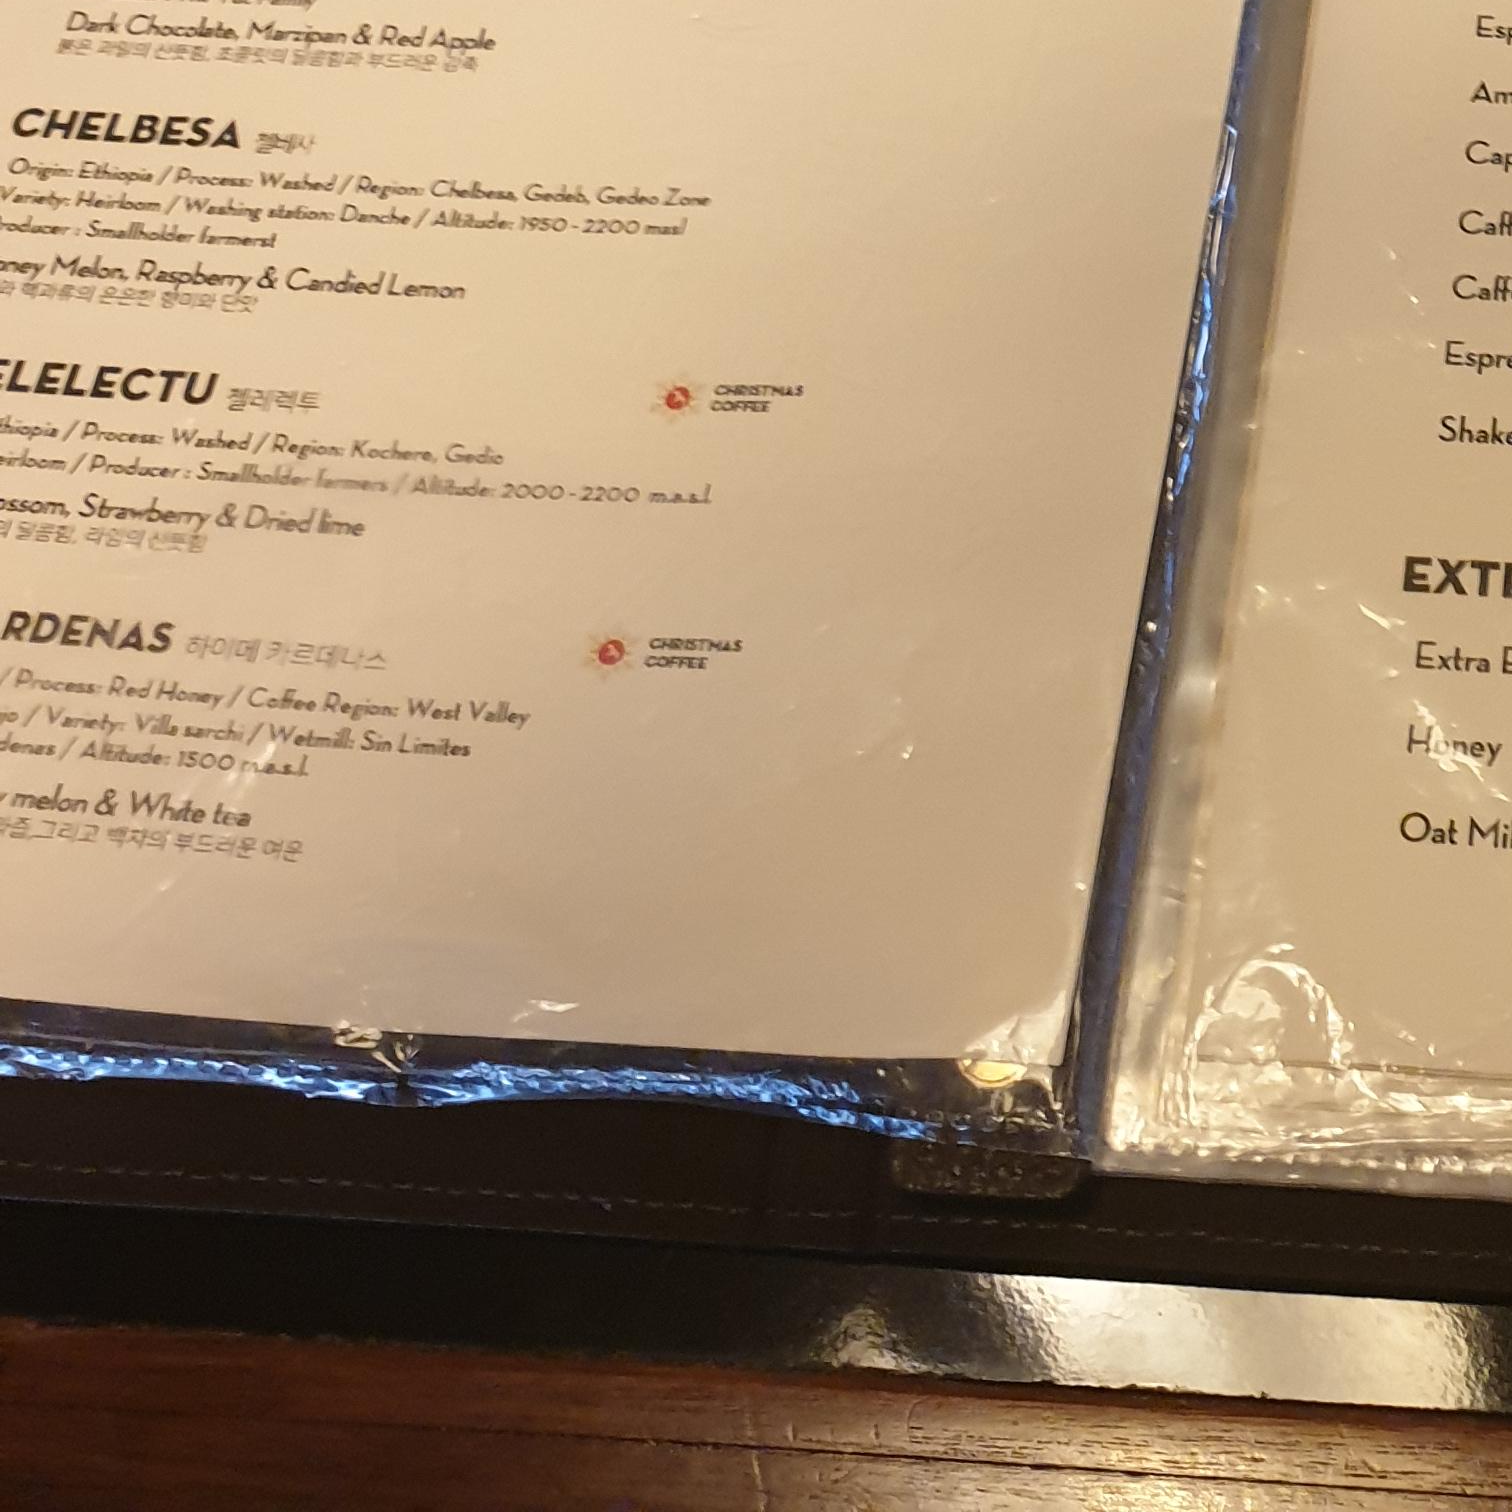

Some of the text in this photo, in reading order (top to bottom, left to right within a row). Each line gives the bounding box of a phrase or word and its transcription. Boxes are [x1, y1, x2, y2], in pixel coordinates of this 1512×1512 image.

[66, 11, 118, 33] Dark
[352, 24, 371, 45] &
[379, 25, 427, 47] Red
[429, 28, 496, 59] Apple
[12, 108, 239, 148] CHELBESA
[136, 259, 252, 295] Raspberry
[256, 266, 278, 289] &
[286, 267, 385, 295] Candied
[387, 273, 465, 298] Lemon
[710, 400, 771, 412] COFFEE
[714, 385, 803, 396] CHRISTMAS
[78, 493, 365, 536] Strawberry & Dried lime
[644, 656, 708, 669] COFFEE
[649, 638, 743, 652] CHRISTMAS
[1416, 641, 1490, 673] Extra
[108, 675, 153, 698] Red
[156, 680, 224, 710] Honey
[247, 687, 317, 712] Coffee
[408, 698, 462, 721] West
[470, 701, 531, 730] Valley
[11, 783, 251, 827] melon & White tea
[1400, 812, 1458, 845] Oat
